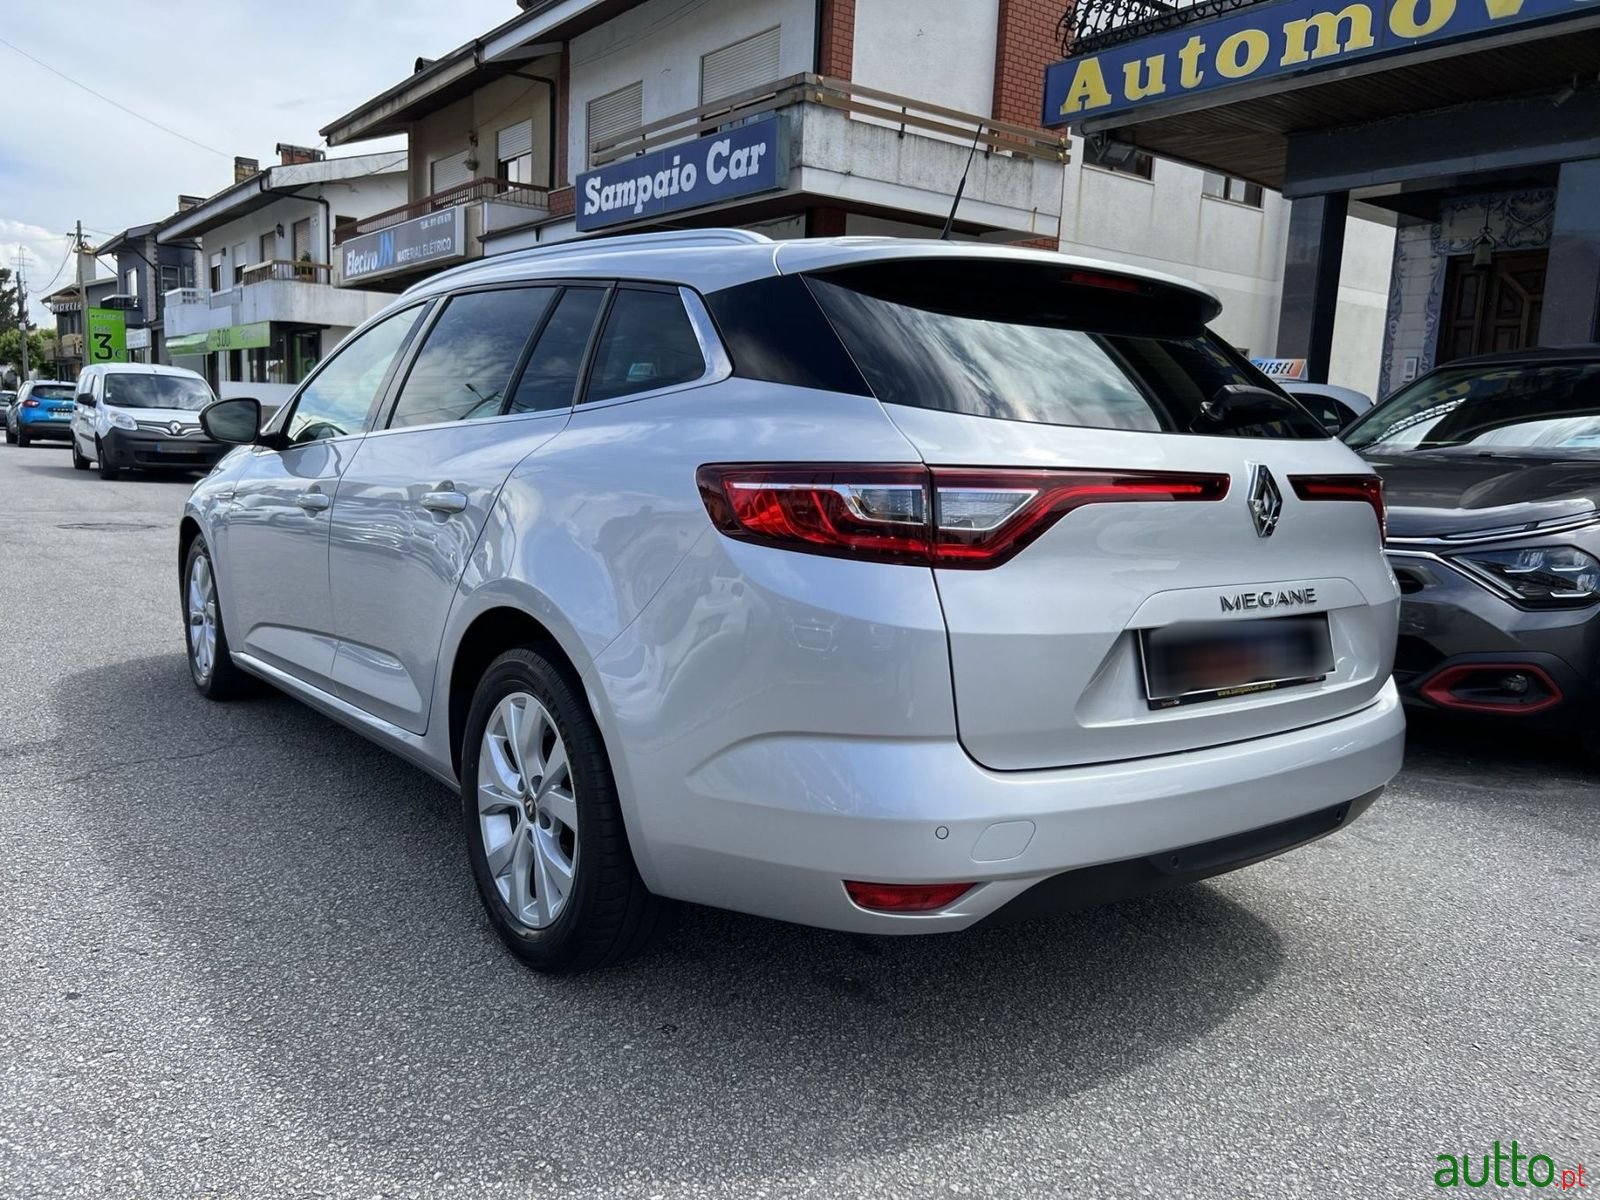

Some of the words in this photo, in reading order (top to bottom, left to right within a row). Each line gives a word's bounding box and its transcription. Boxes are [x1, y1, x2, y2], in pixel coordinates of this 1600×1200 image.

[584, 155, 698, 215] Sampaio
[706, 138, 767, 185] Car
[397, 245, 422, 263] MATERIAL
[422, 237, 452, 257] ELÉTRICO
[1220, 588, 1318, 613] MEGANE
